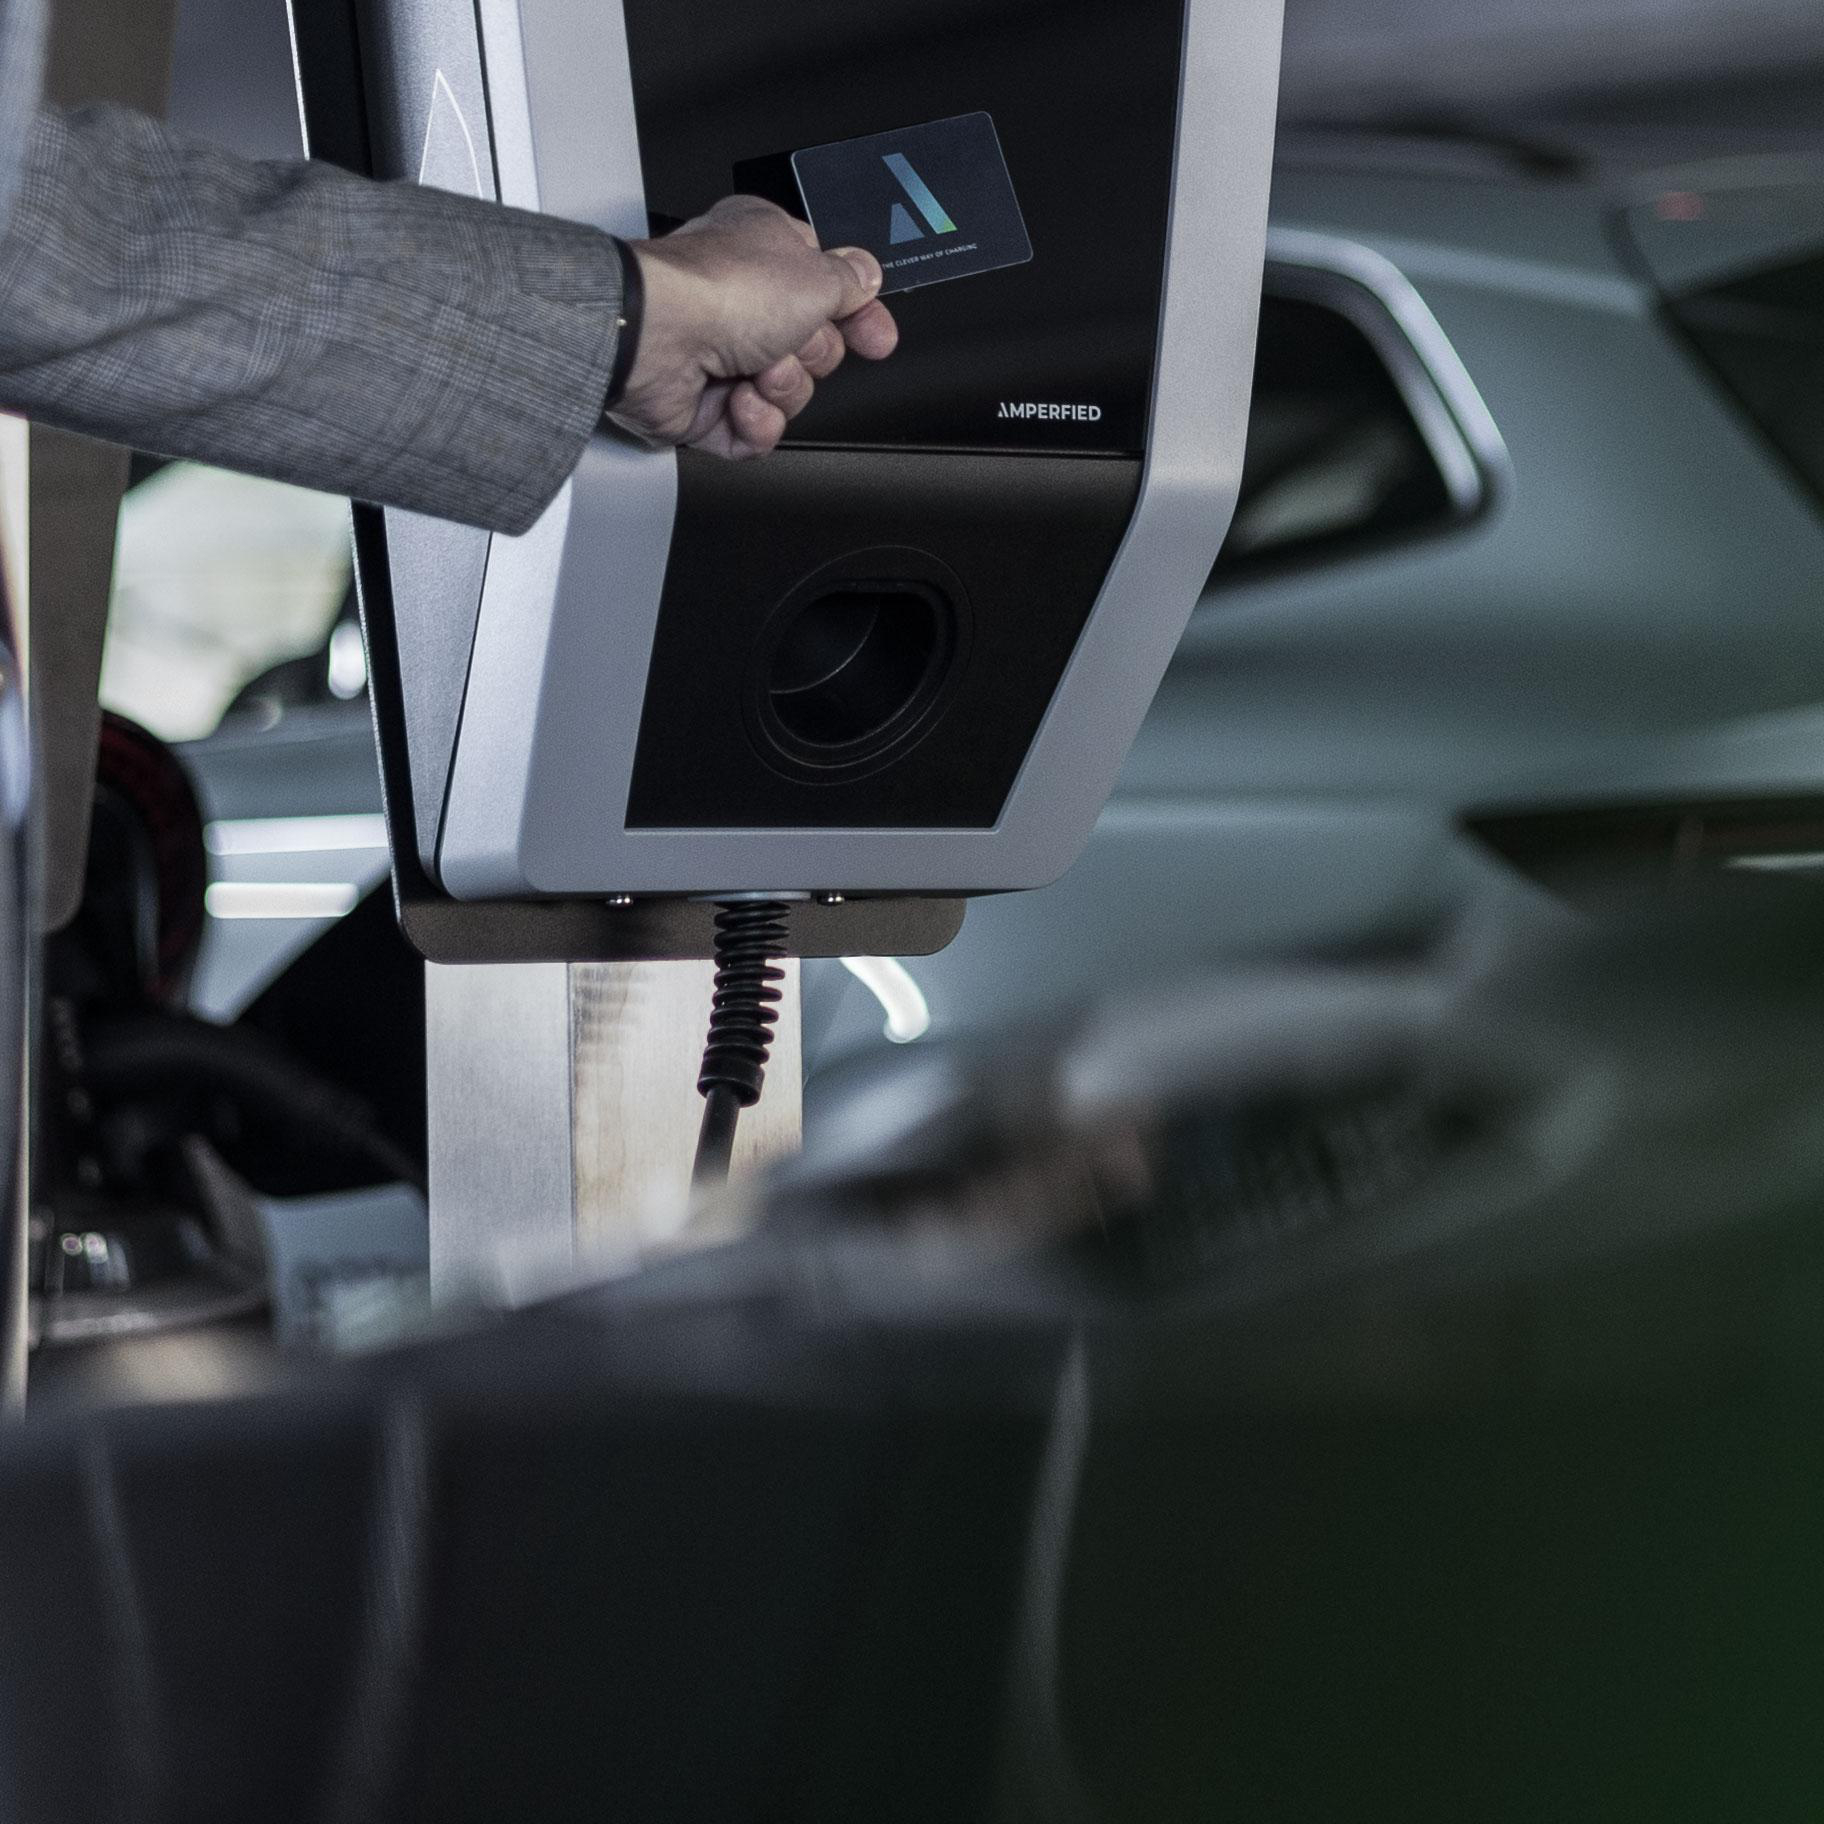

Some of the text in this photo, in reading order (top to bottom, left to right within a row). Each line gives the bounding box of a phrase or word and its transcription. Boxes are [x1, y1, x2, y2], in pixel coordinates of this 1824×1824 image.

[895, 255, 919, 267] CLEVER
[919, 253, 934, 262] WAY
[934, 250, 943, 258] OF
[998, 402, 1101, 421] AMPERFIED
